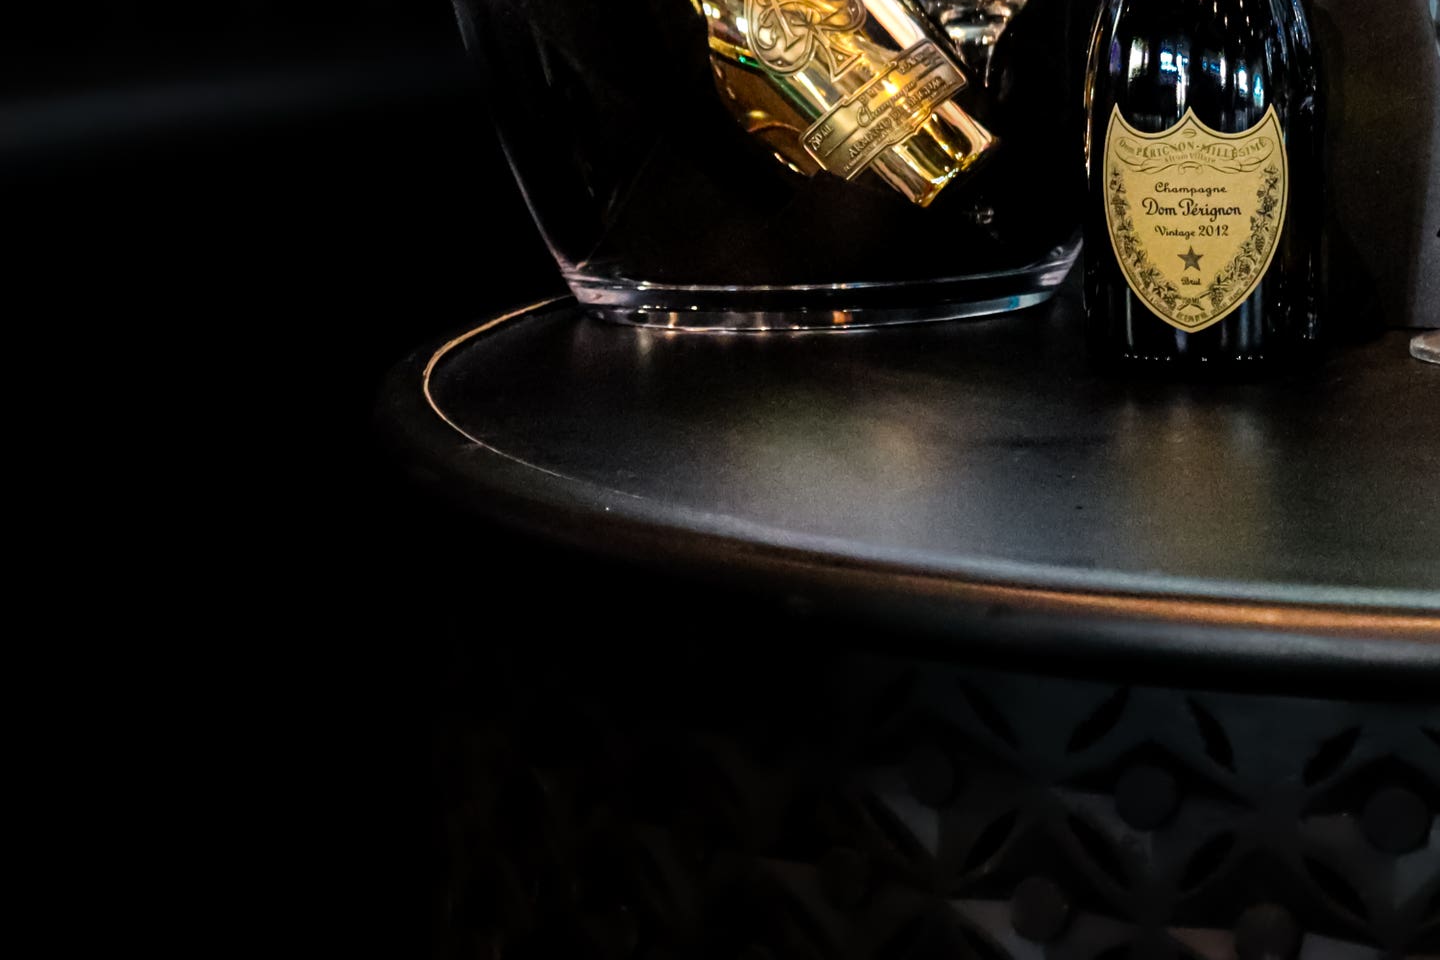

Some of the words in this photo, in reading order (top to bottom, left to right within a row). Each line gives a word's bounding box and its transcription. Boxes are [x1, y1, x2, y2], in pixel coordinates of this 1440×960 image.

[1155, 181, 1227, 197] Champagne
[1142, 197, 1177, 216] Dom
[1178, 197, 1242, 222] Pérignon
[1154, 225, 1196, 240] Vintage
[1198, 224, 1229, 237] 2012
[1180, 276, 1202, 286] Brut
